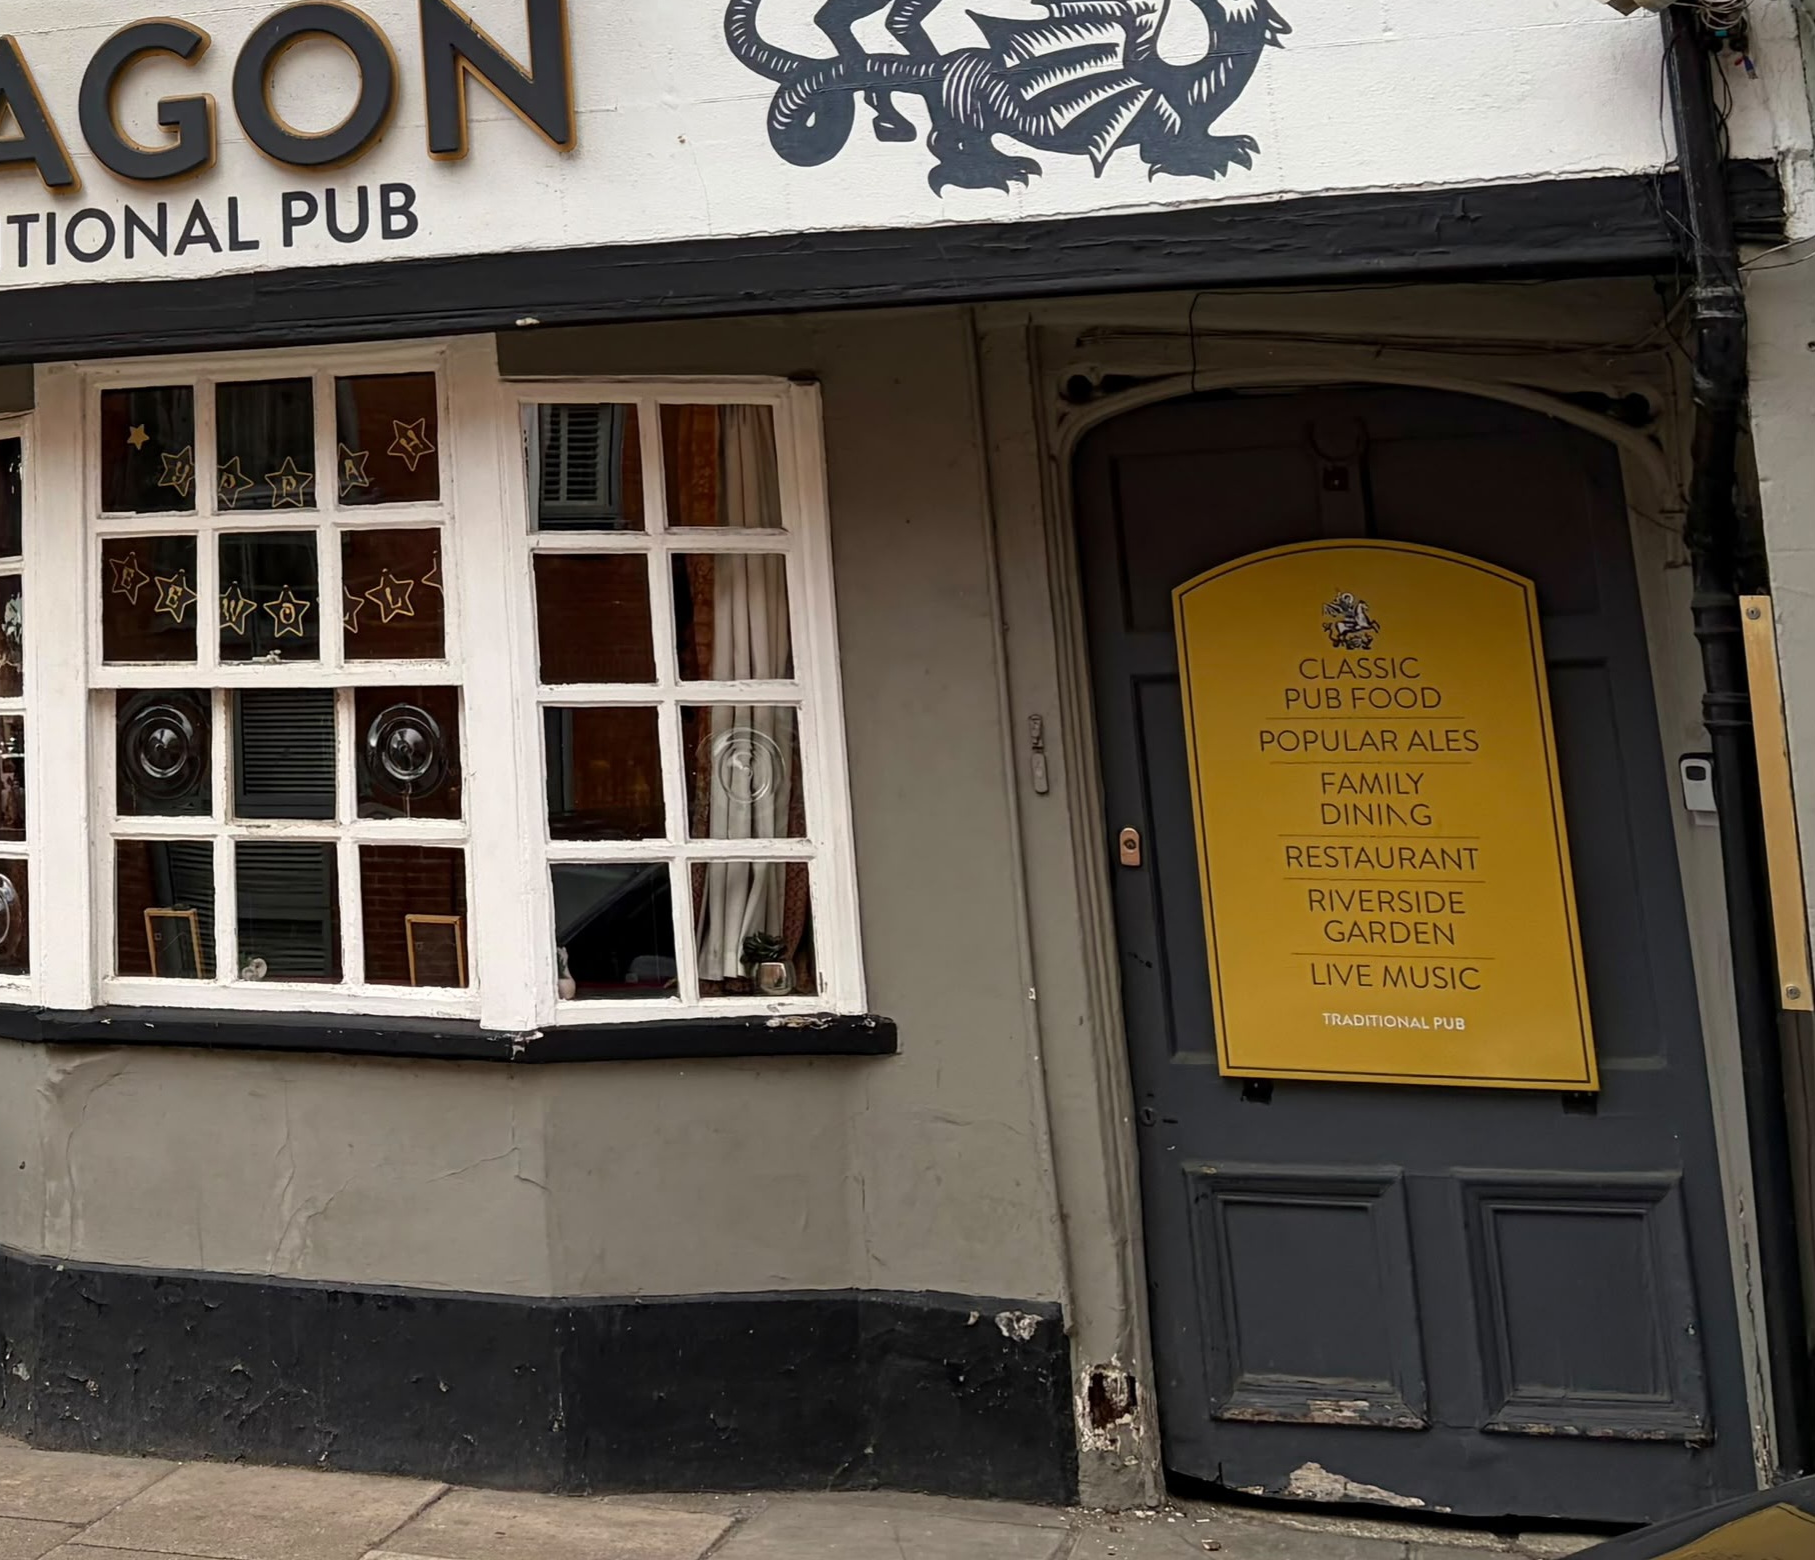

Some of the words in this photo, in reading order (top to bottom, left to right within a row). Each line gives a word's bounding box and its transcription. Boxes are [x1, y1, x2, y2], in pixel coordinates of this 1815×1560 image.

[281, 182, 419, 247] PUB
[1299, 657, 1421, 680] CLASSIC
[1285, 688, 1341, 710] PUB
[1351, 688, 1441, 709] FOOD
[1260, 729, 1398, 752] POPULAR
[1407, 730, 1480, 752] ALES
[1321, 772, 1424, 795] FAMILY
[1321, 803, 1432, 827] DINING
[1286, 845, 1479, 871] RESTAURANT
[1308, 889, 1465, 914] RIVERSIDE
[1324, 920, 1455, 946] GARDEN
[1311, 962, 1373, 988] LIVE
[1382, 964, 1481, 990] MUSIC
[1322, 1012, 1430, 1030] TRADITIONAL
[1433, 1016, 1466, 1031] PUB
